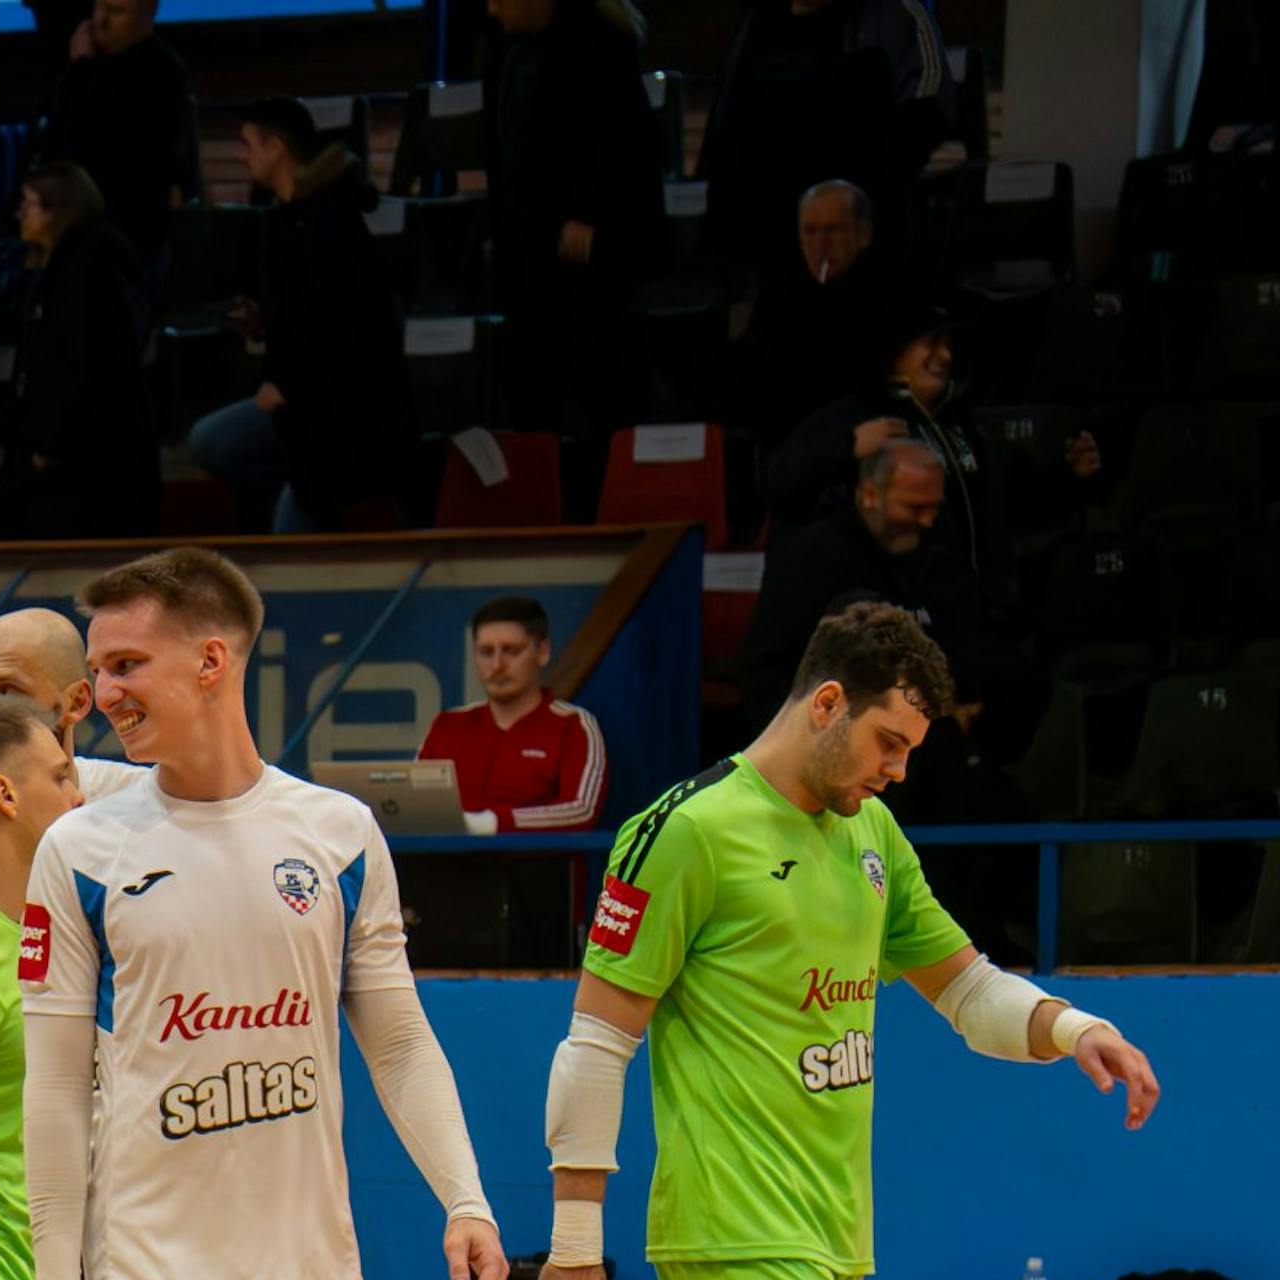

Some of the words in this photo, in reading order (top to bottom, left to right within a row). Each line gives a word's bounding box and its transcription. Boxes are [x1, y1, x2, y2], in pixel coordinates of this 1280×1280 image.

[599, 889, 641, 920] Super
[157, 987, 313, 1044] Kandit
[798, 966, 876, 1013] Kandi
[159, 1054, 318, 1141] saltas
